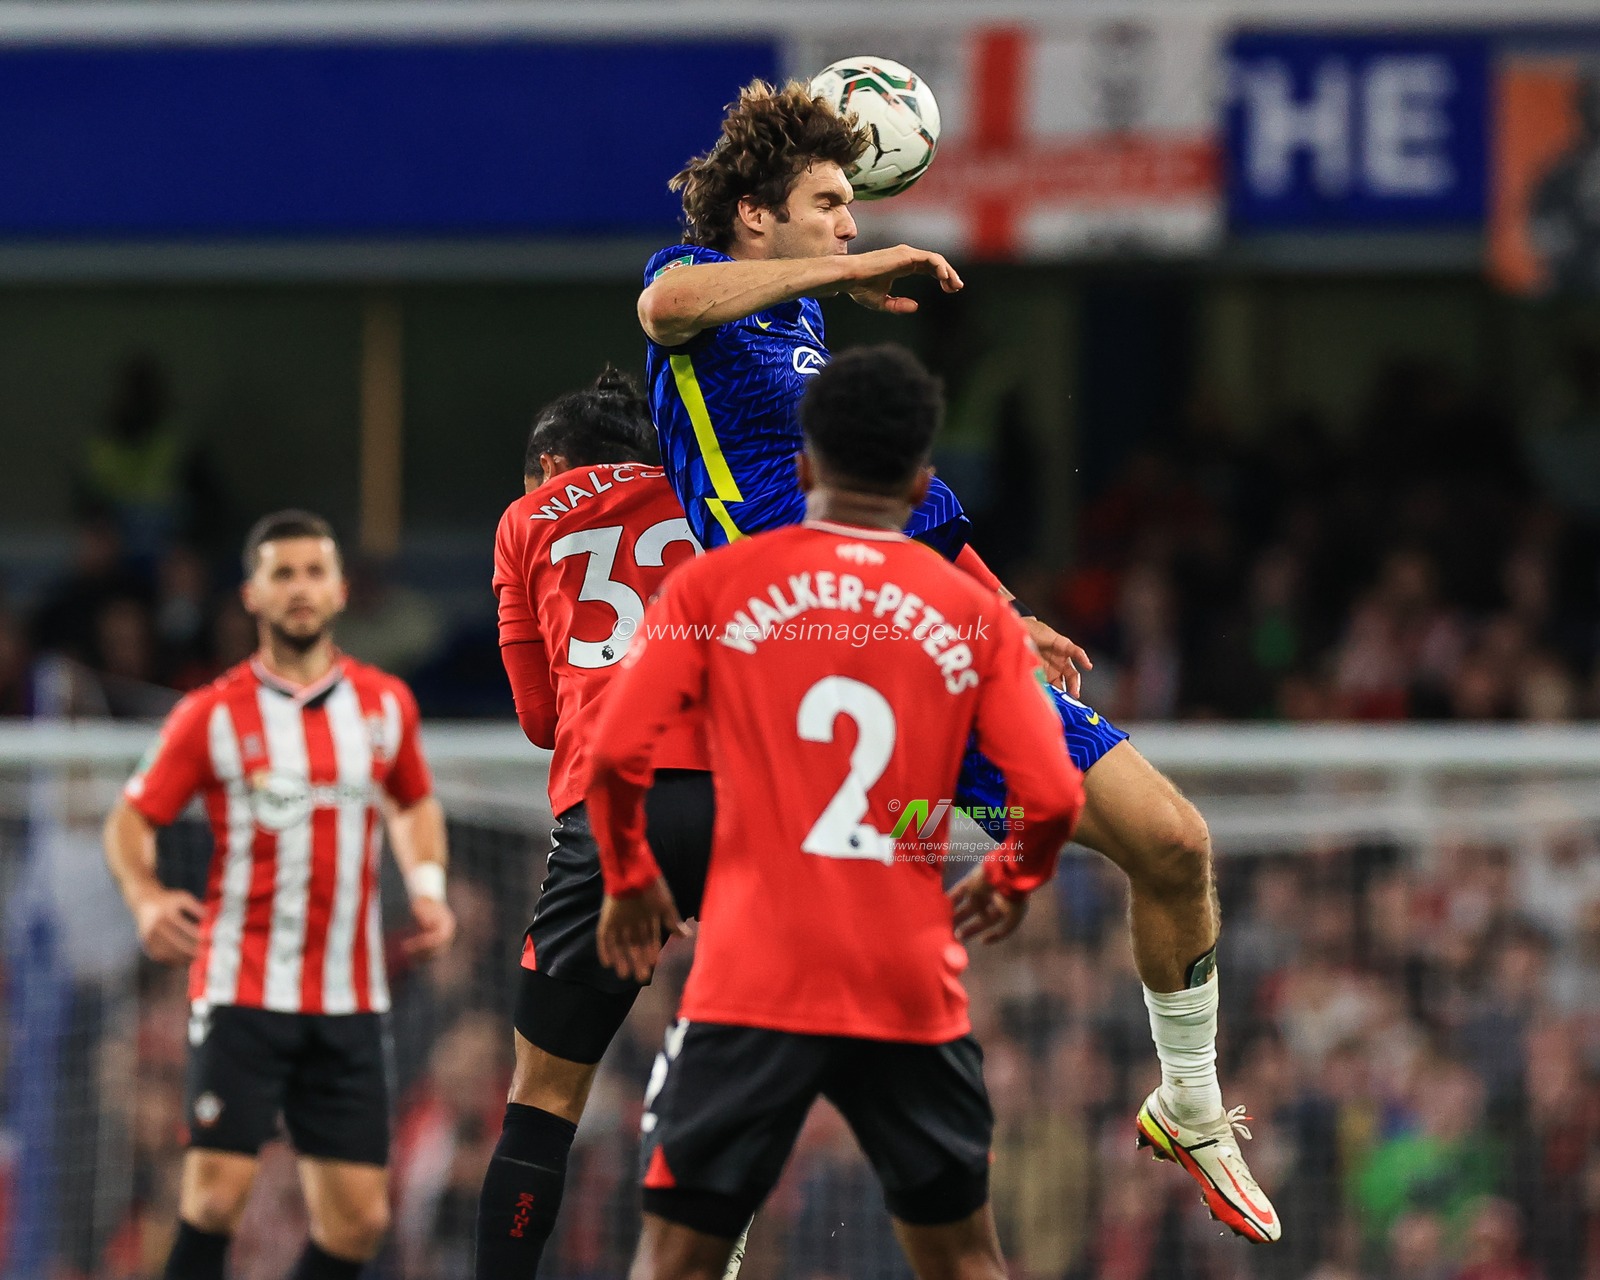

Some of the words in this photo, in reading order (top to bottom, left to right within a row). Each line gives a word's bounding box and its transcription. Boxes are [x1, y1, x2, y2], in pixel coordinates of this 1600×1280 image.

[1224, 58, 1454, 196] HE
[721, 571, 979, 695] WALKER-PETERS
[796, 674, 897, 866] 2
